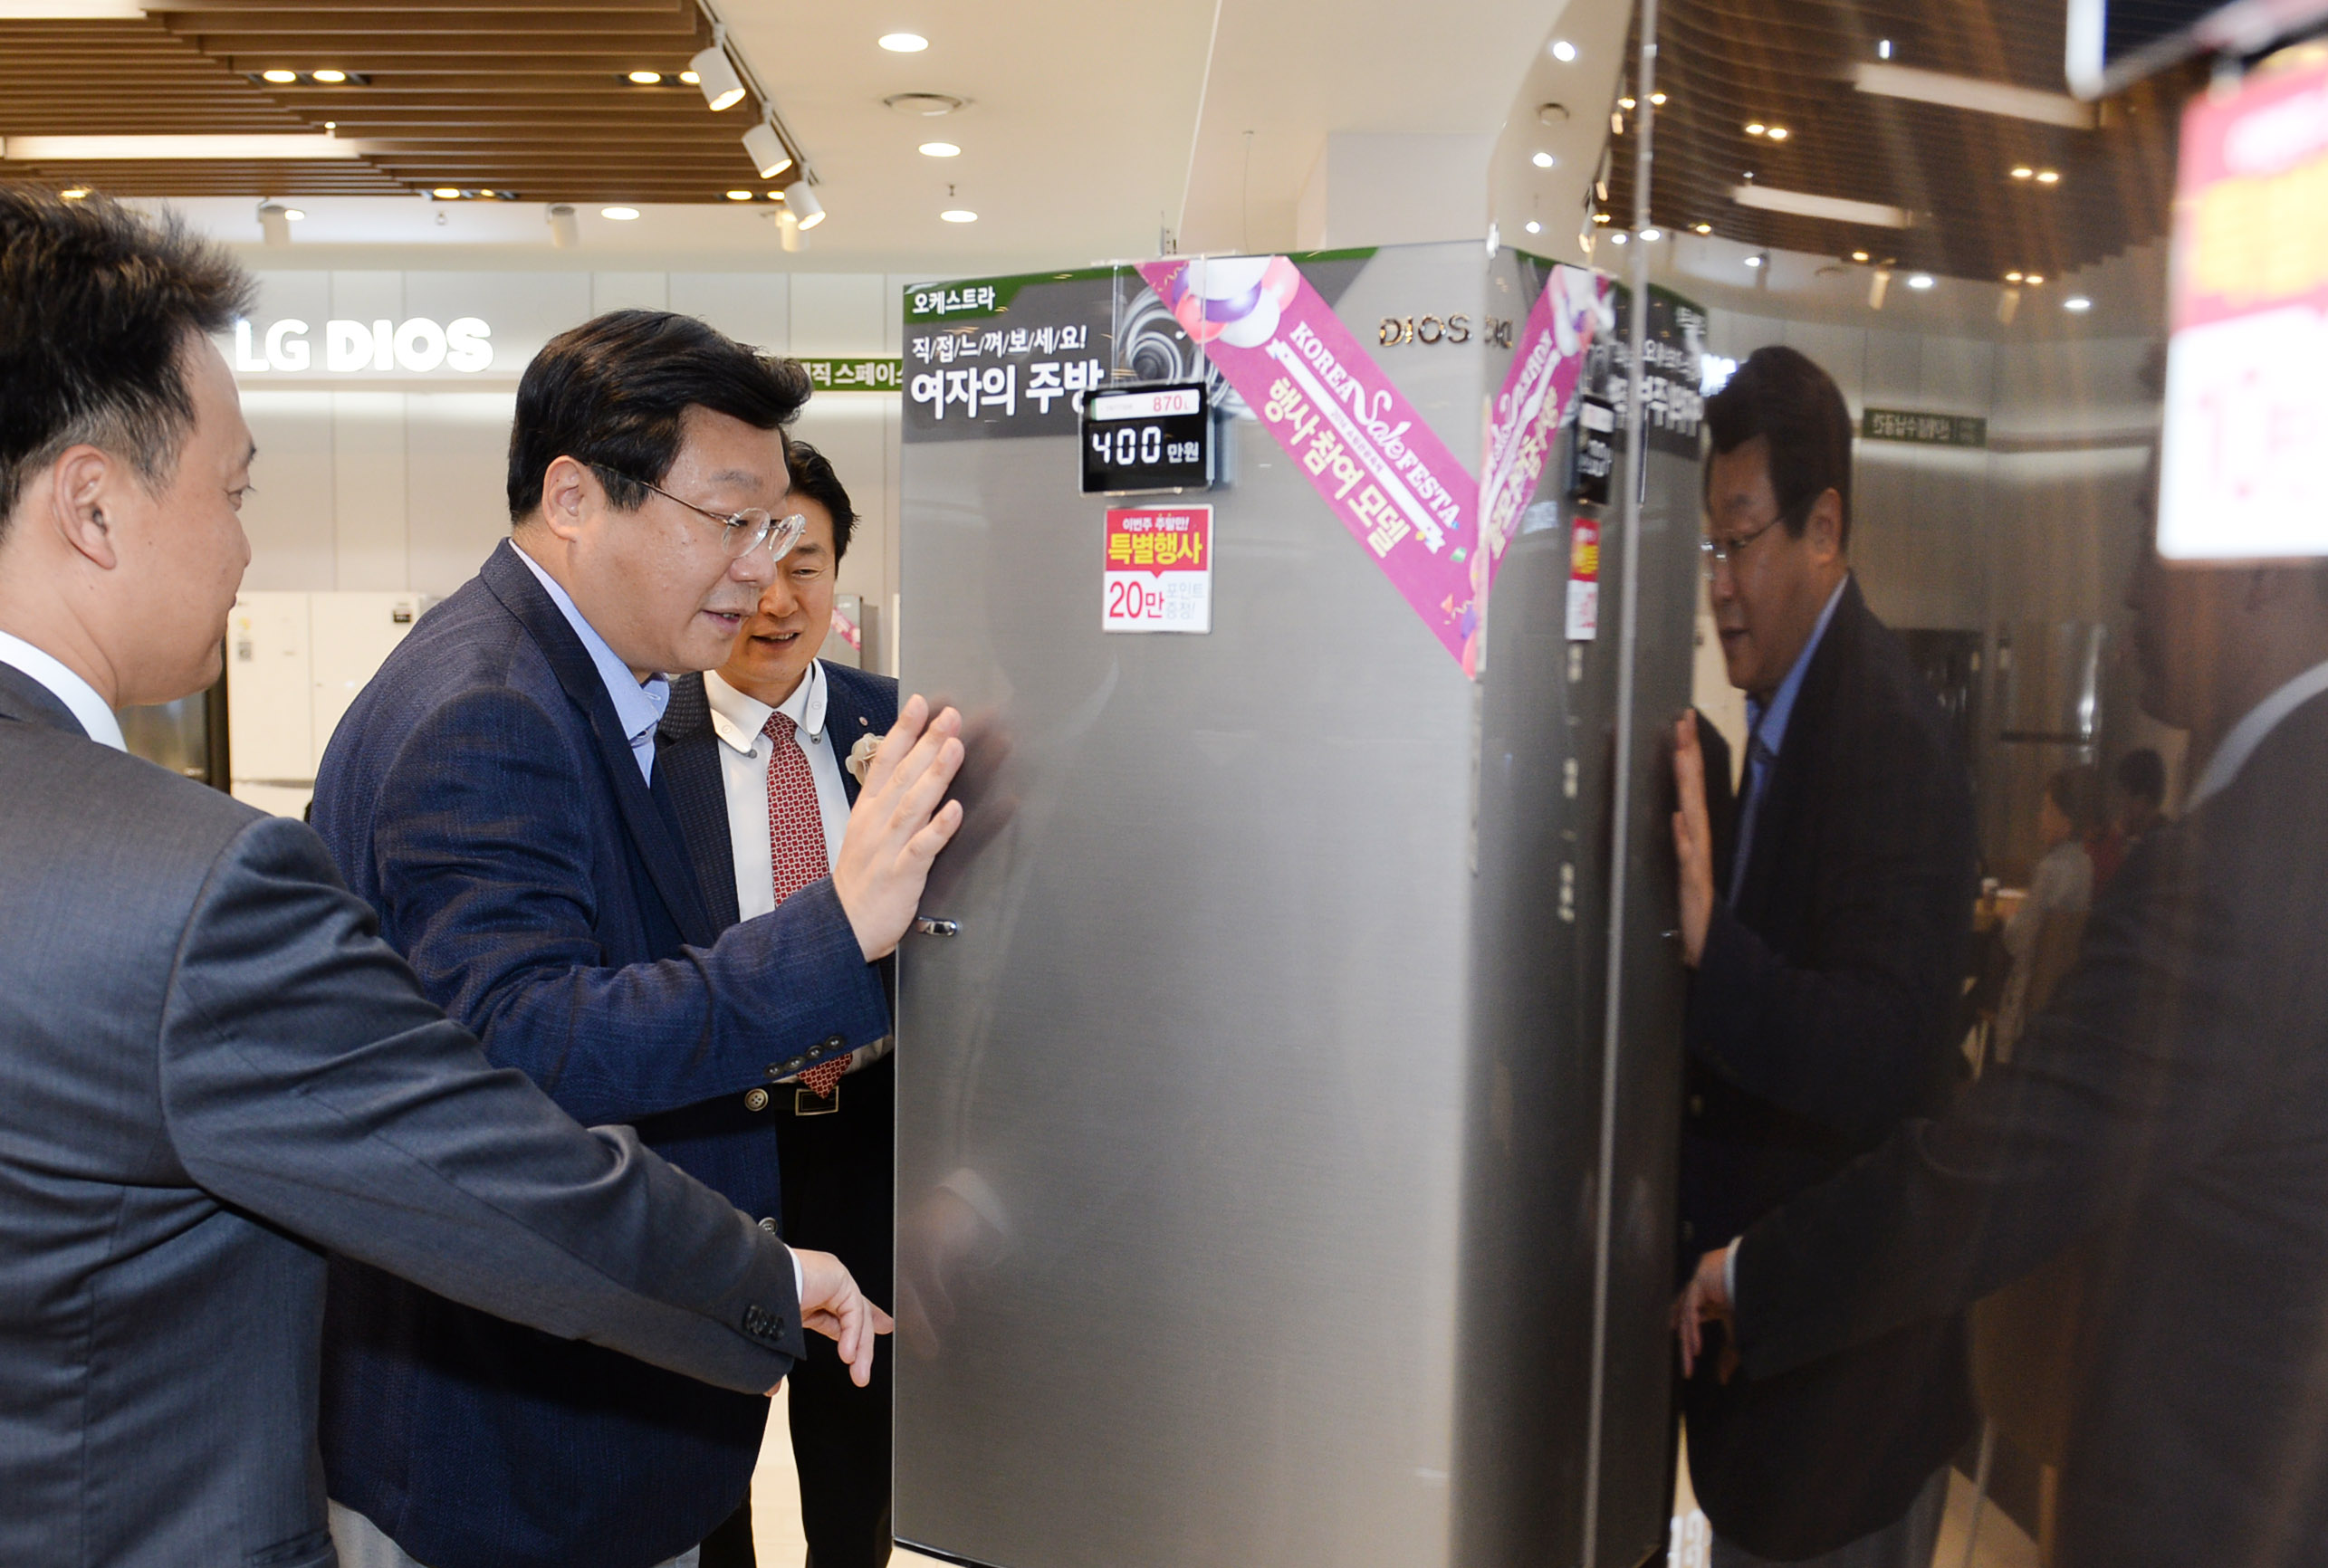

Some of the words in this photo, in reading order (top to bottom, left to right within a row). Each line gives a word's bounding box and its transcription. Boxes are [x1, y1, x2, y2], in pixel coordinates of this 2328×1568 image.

[912, 286, 995, 315] 오케스트라
[235, 319, 311, 372] LG
[326, 317, 494, 372] DIOS
[1380, 312, 1472, 346] DIOS
[911, 366, 1016, 419] 여자의
[1025, 358, 1105, 415] 주방
[1289, 320, 1356, 403] KOREA
[1346, 375, 1412, 460] Sale
[1394, 448, 1461, 528] FESTA
[1092, 425, 1162, 465] 400
[1166, 441, 1200, 464] 만원
[1264, 377, 1320, 445] 행사
[1303, 430, 1365, 501] 참여
[1347, 483, 1412, 559] 모델
[1108, 531, 1203, 565] 특별행사
[1108, 579, 1165, 619] 20만
